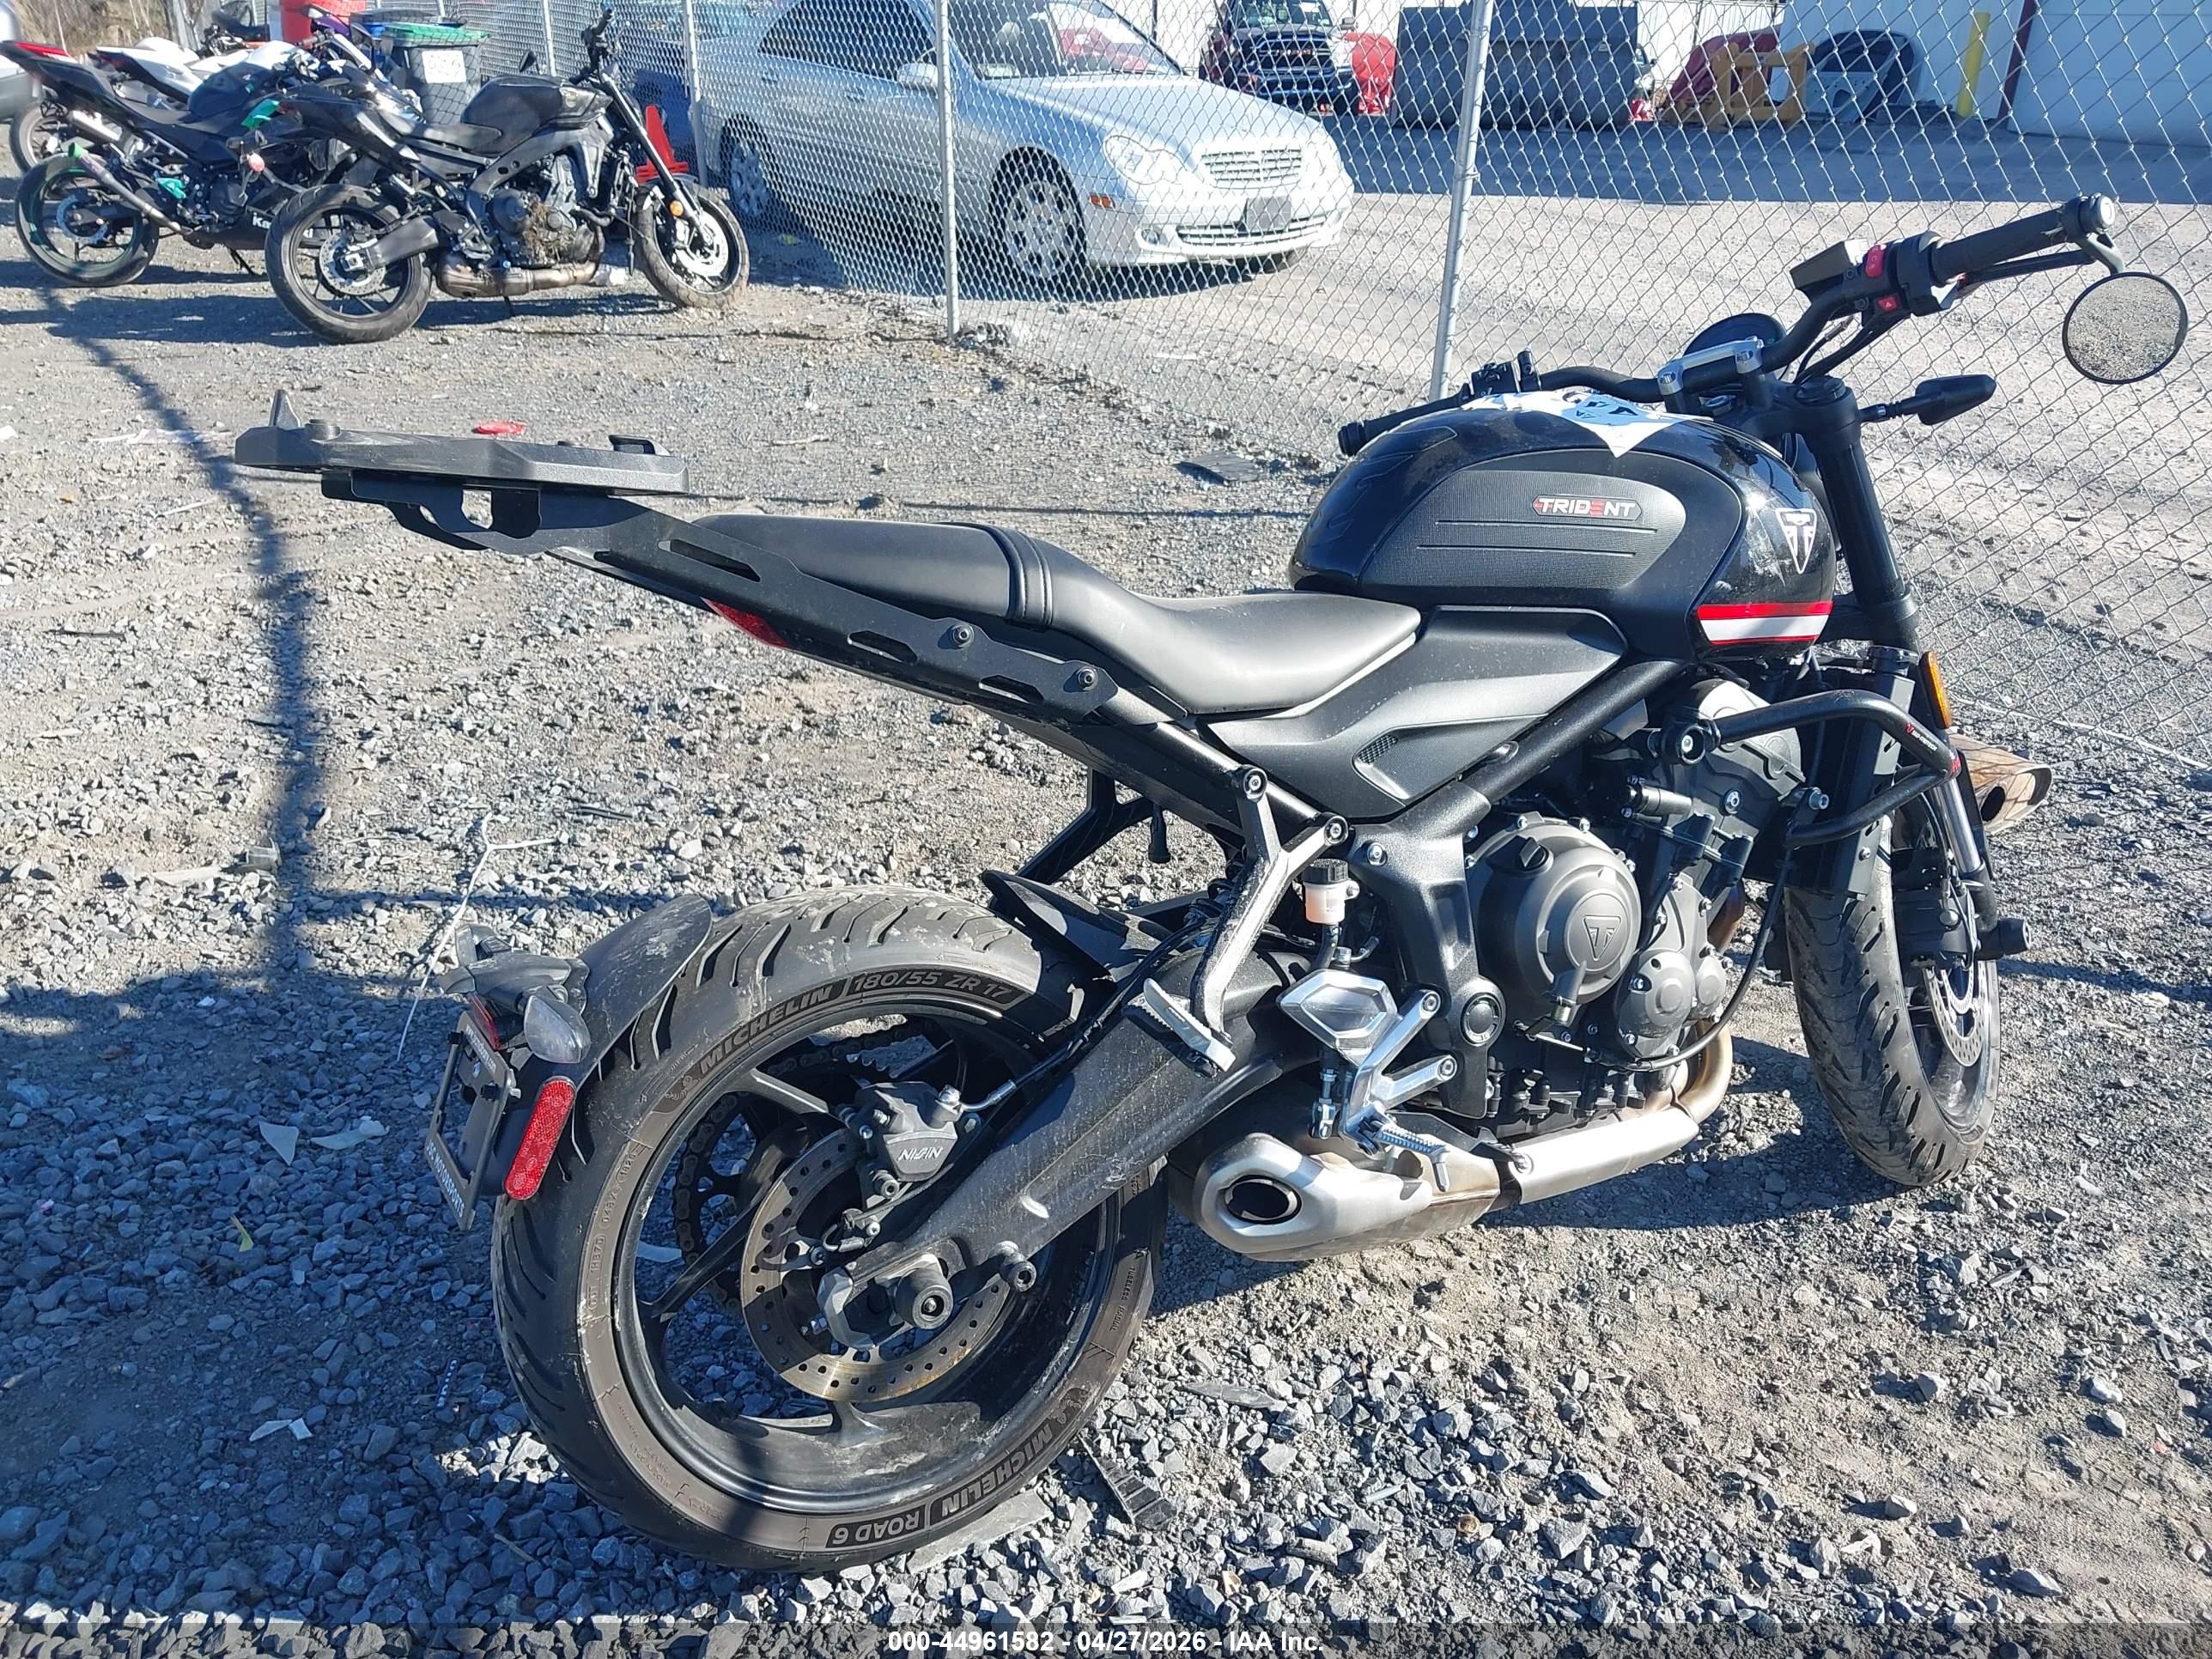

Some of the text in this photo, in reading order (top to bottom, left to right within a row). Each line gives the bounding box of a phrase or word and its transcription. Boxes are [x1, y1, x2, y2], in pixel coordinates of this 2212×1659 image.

[1535, 497, 1636, 517] TRIDENT
[854, 970, 1013, 999] 180/55 ZR 17
[700, 985, 833, 1075] MICHELIN
[434, 1155, 465, 1218] MOTORSPORTS
[831, 1422, 1054, 1546] MICHELIN ROAD 6
